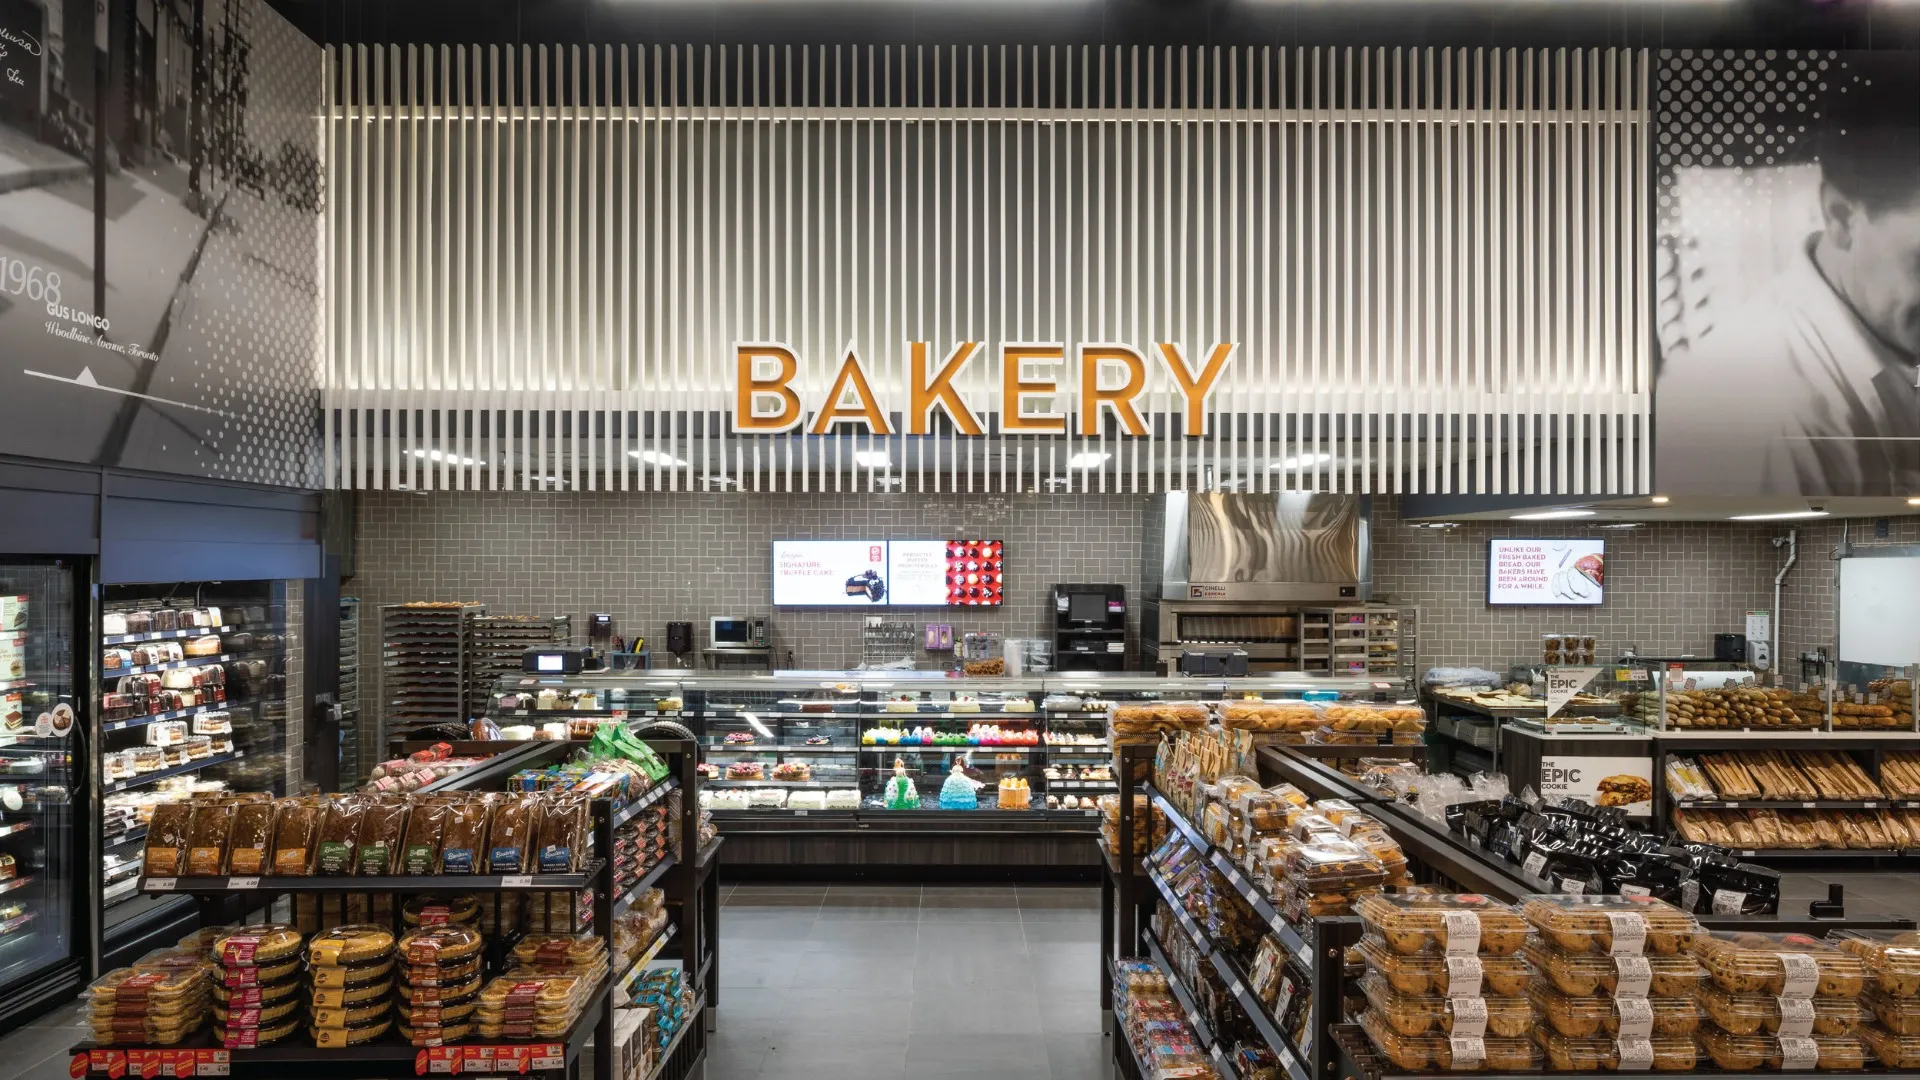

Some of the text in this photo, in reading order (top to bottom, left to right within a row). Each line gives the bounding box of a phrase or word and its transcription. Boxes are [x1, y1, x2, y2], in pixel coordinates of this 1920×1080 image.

[0, 256, 62, 305] 1968
[46, 302, 110, 331] GUS LONGO
[45, 320, 91, 344] Woodbine
[128, 343, 159, 362] Toronto
[731, 338, 1241, 437] BAKERY
[1550, 679, 1577, 689] EPIC
[1541, 768, 1581, 783] EPIC
